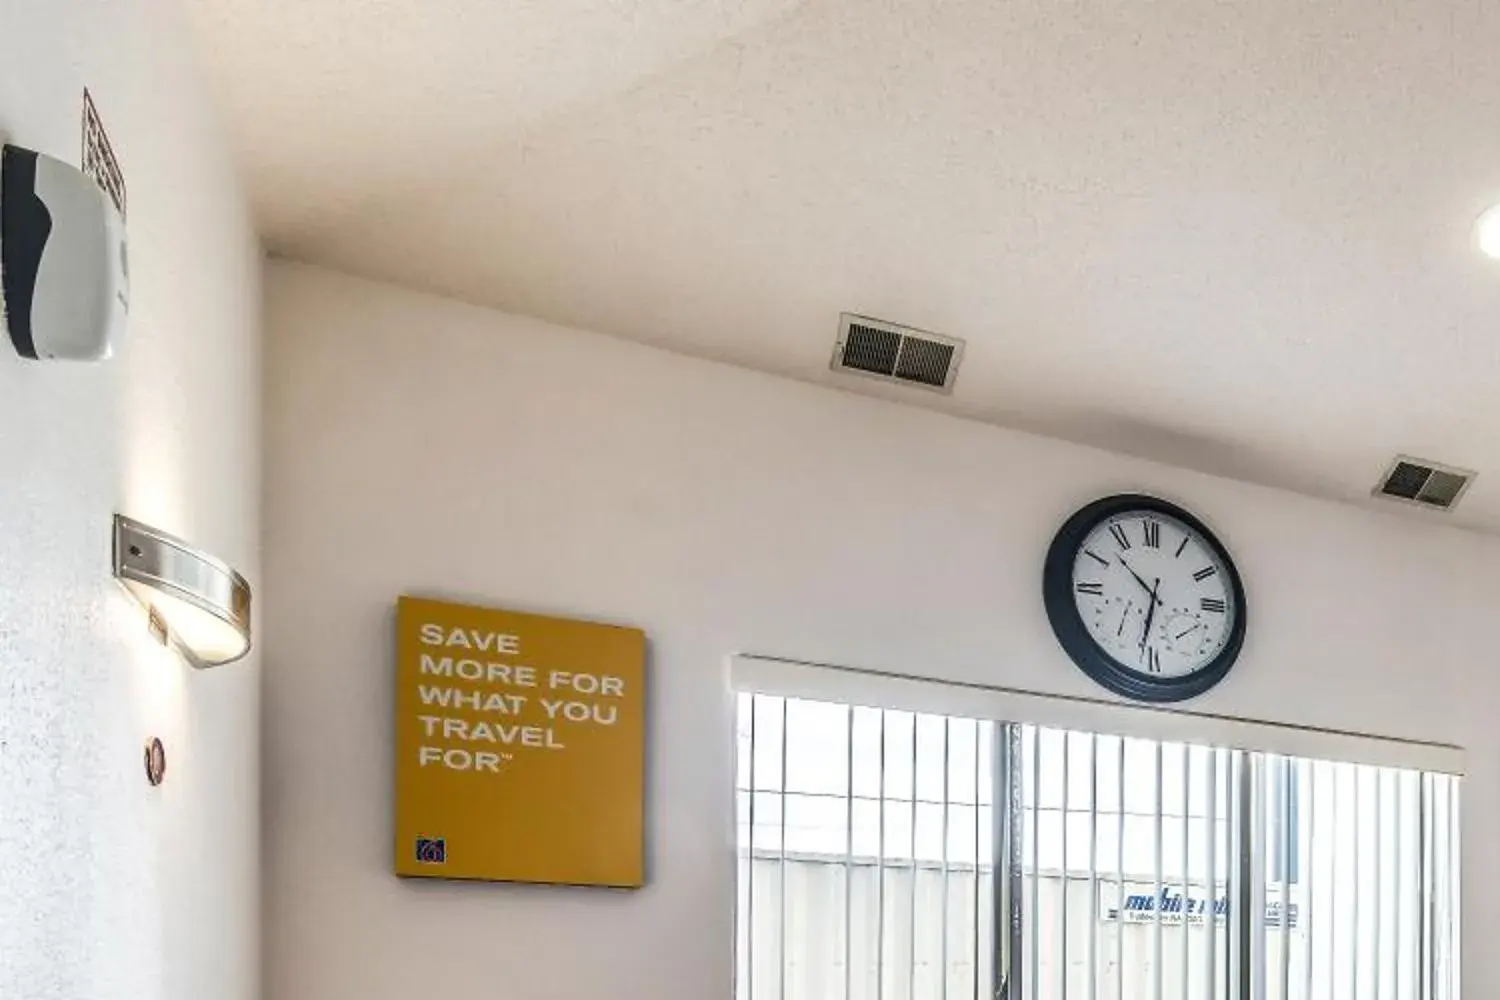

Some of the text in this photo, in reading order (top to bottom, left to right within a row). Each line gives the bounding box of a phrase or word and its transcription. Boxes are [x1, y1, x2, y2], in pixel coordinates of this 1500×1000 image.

[419, 623, 520, 655] SAVE
[419, 654, 625, 697] MORE FOR
[418, 685, 618, 726] WHAT YOU
[417, 715, 565, 749] TRAVEL
